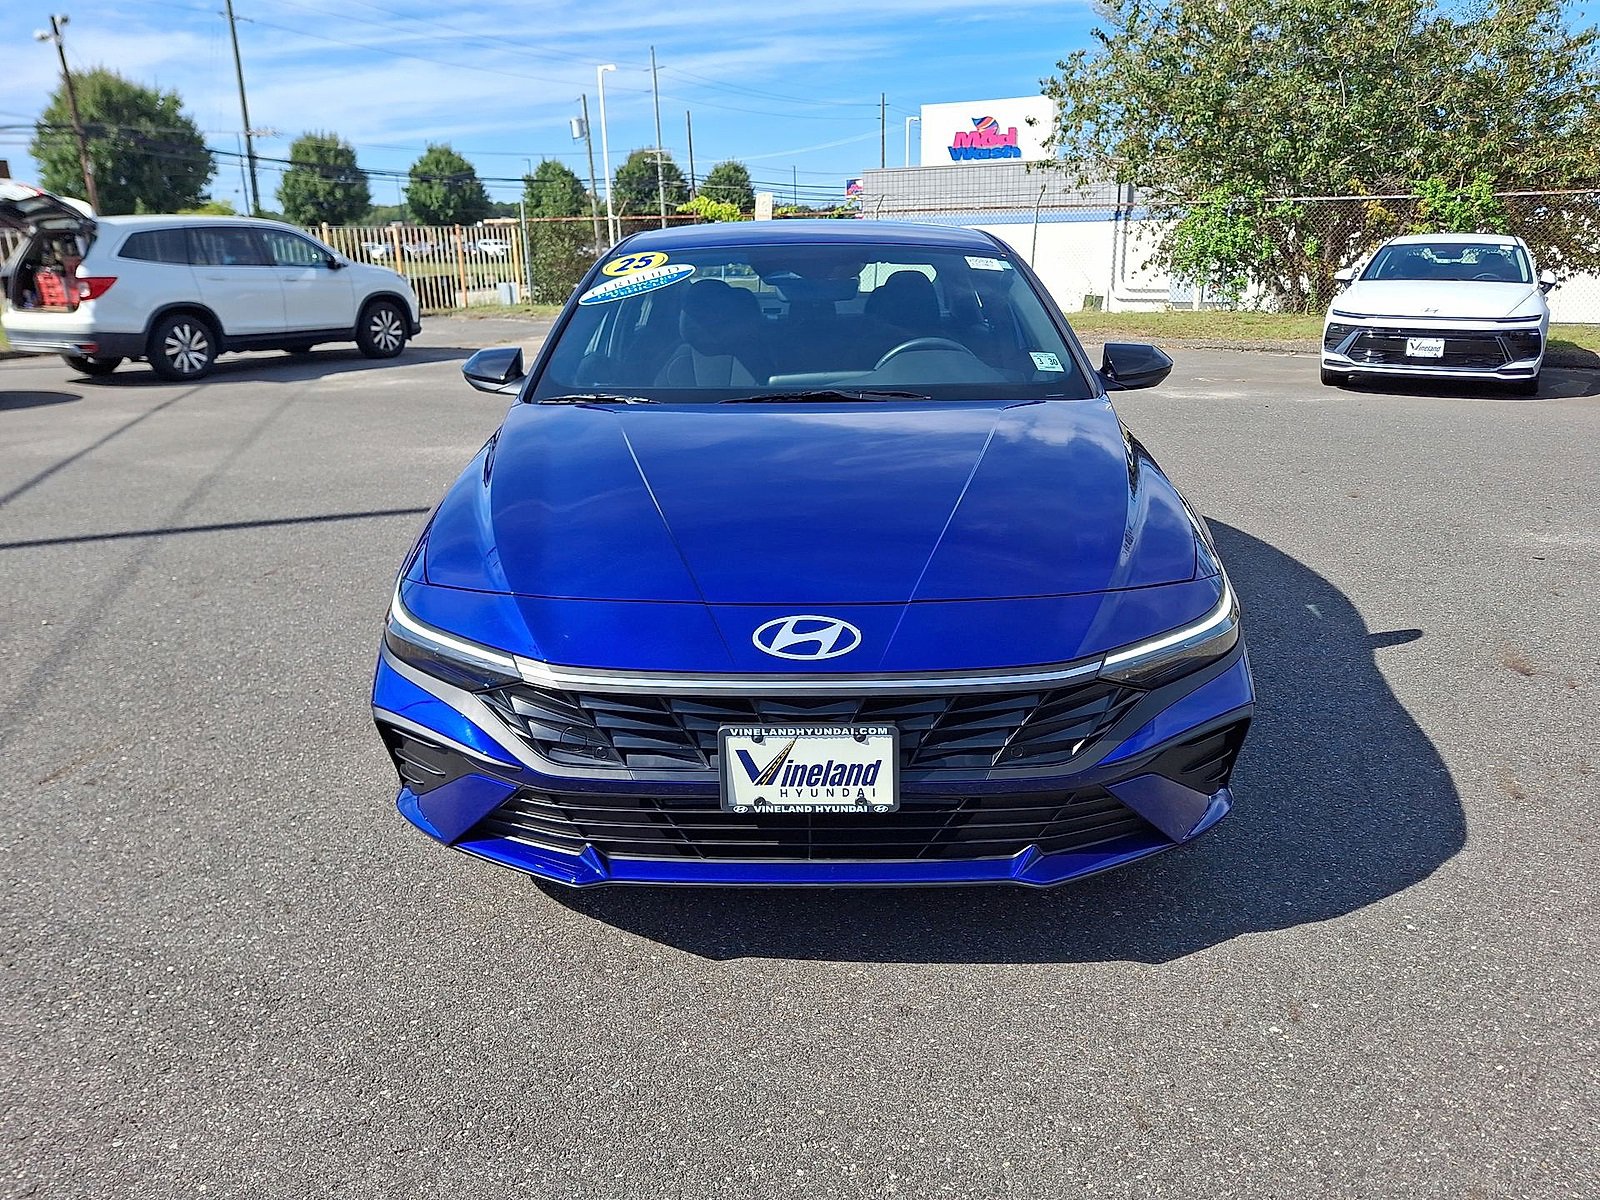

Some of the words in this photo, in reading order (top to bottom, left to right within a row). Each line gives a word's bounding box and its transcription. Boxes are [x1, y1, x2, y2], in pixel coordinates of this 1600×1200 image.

[948, 145, 1021, 161] Wash
[613, 254, 656, 273] 25
[1048, 357, 1059, 366] 30
[729, 727, 889, 736] VINELANDHYUNDAI.COM
[735, 737, 882, 787] Vineland
[780, 788, 876, 798] HYUNDAI
[753, 805, 812, 814] VINELAND
[815, 805, 868, 814] HYUNDAI
